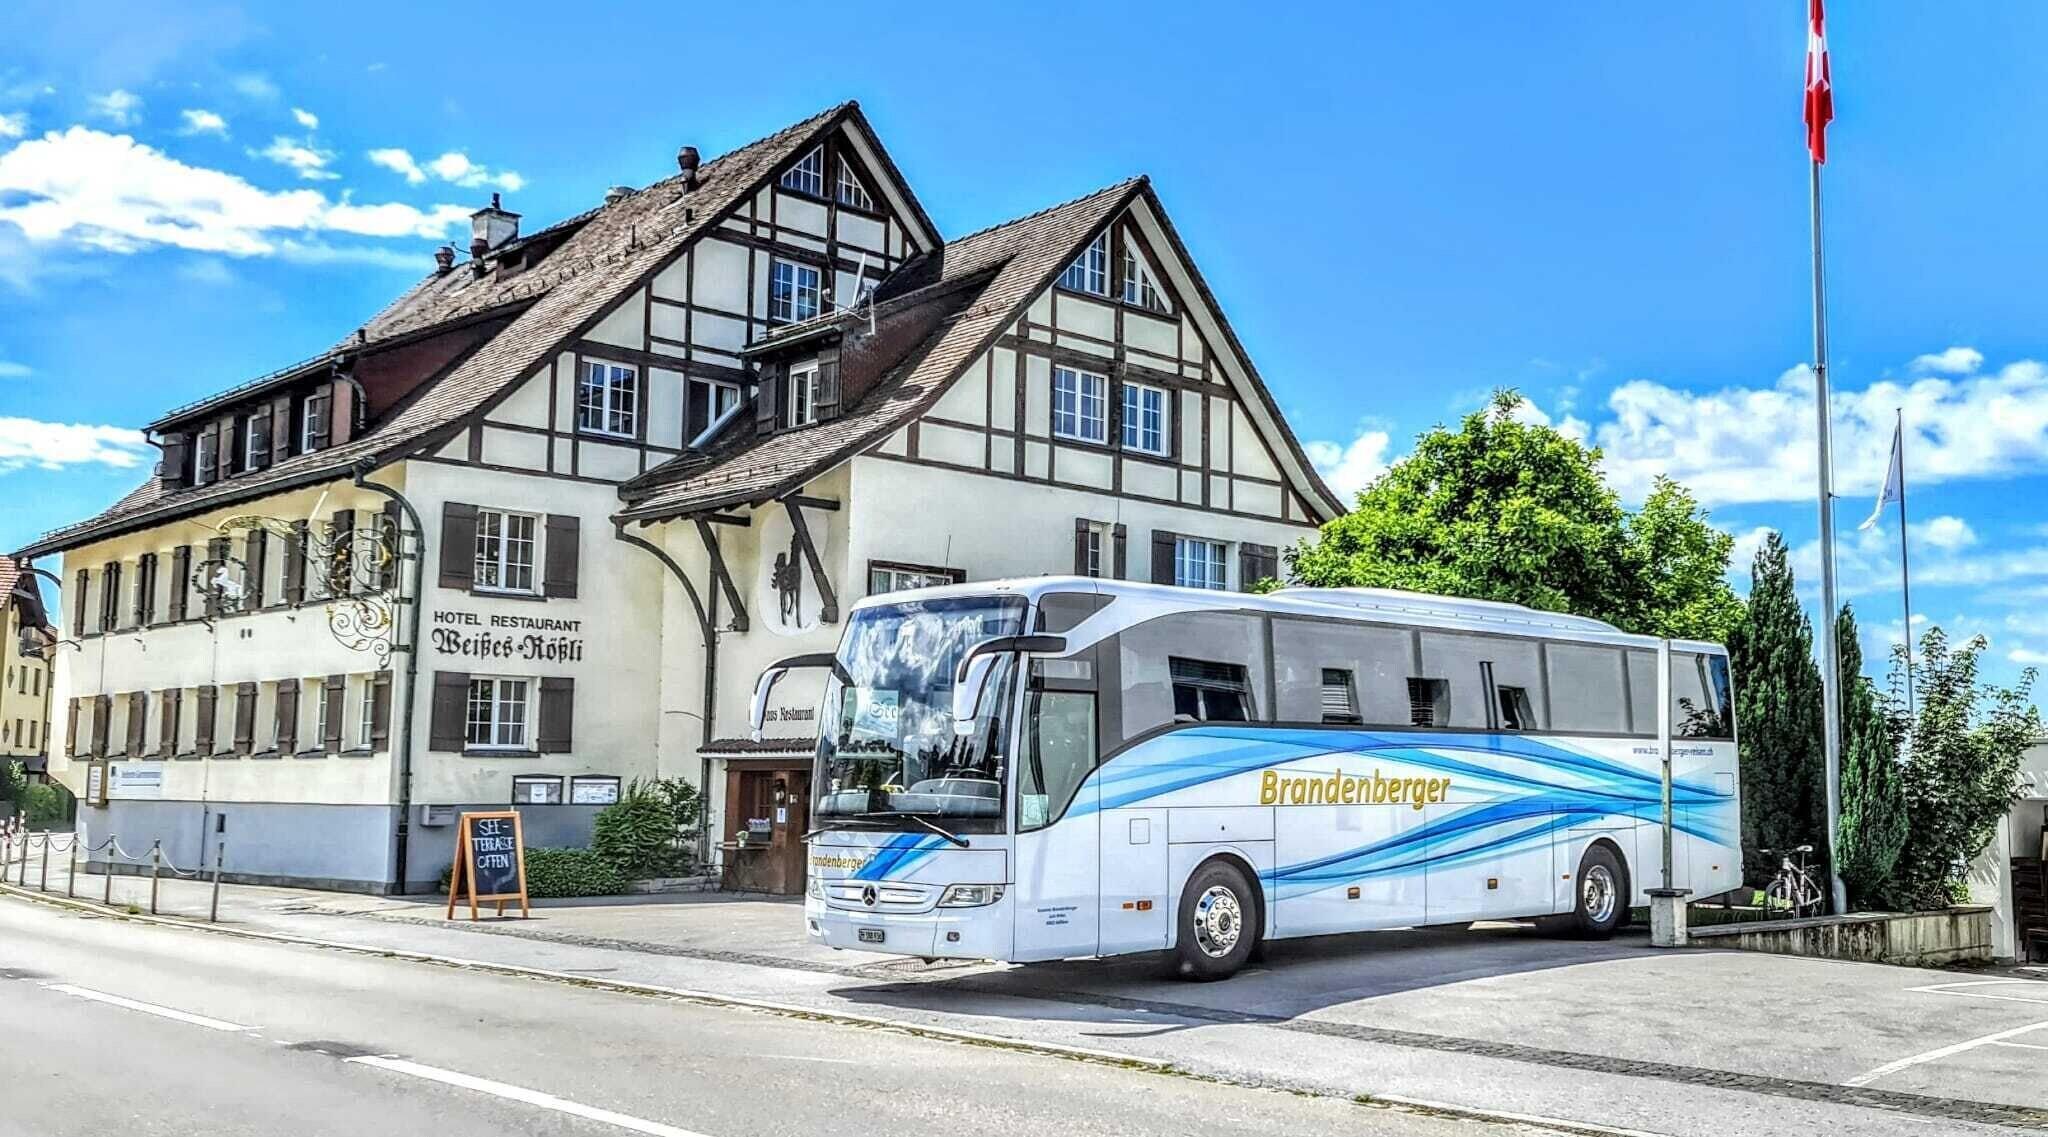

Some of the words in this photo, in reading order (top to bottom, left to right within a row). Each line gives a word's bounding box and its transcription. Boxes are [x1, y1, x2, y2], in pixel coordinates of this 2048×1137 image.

[434, 610, 482, 626] HOTEL
[490, 615, 582, 632] RESTAURANT
[780, 706, 815, 721] Restaurant
[1260, 768, 1451, 810] Brandenberger
[471, 836, 515, 852] TERRASSE
[477, 854, 509, 868] OFFEN
